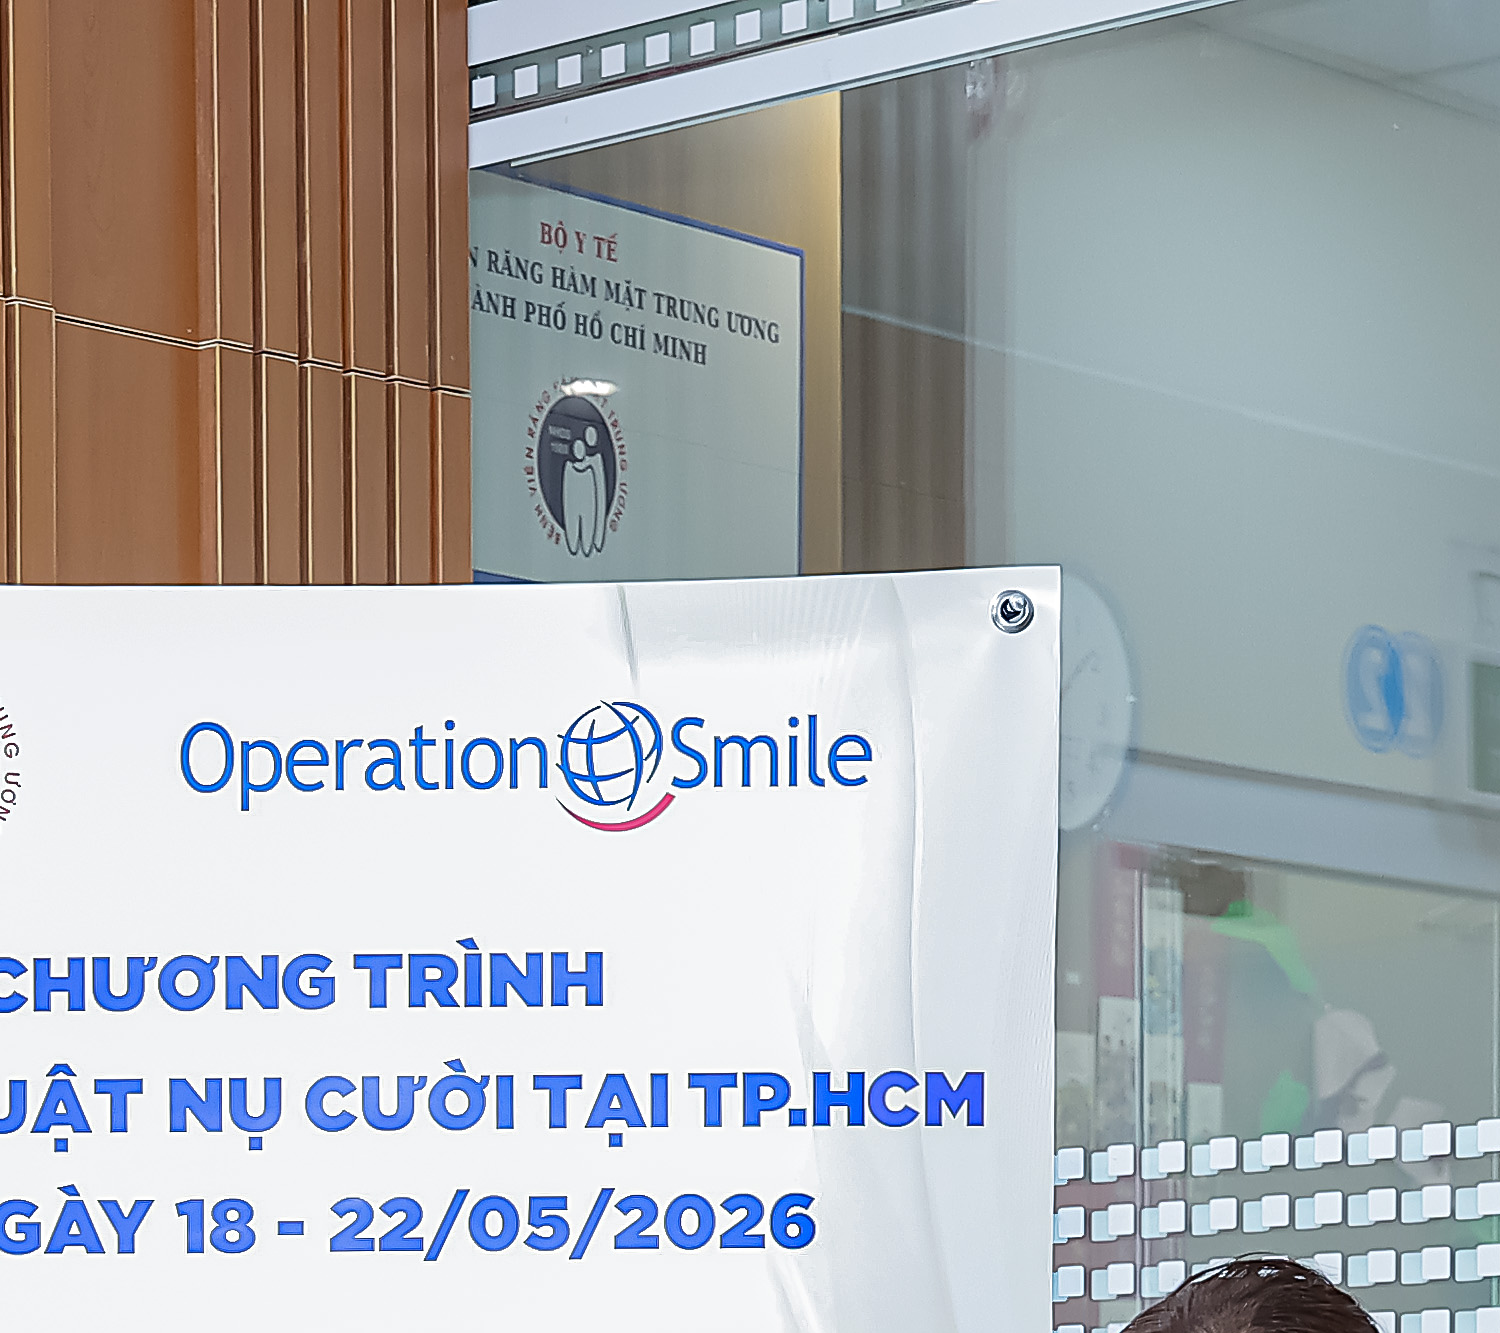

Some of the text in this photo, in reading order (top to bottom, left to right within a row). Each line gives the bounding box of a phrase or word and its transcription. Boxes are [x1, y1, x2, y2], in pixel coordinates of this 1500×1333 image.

[540, 220, 618, 263] BỘ Y TẾ
[471, 284, 516, 320] ÀNH
[524, 301, 566, 331] PHỐ
[610, 322, 645, 350] CHÍ
[653, 333, 707, 365] MINH
[487, 249, 543, 285] RĂNG
[551, 265, 597, 298] HÀM
[604, 280, 646, 312] MẶT
[653, 291, 719, 329] TRUNG
[726, 310, 779, 344] ƯƠNG
[179, 712, 874, 812] Operation Smile
[353, 937, 603, 1008] TRÌNH
[169, 1077, 282, 1151] NỤ
[305, 1058, 514, 1132] CƯỜI
[542, 1073, 669, 1147] TẠI
[688, 1071, 985, 1127] TP.HCM
[175, 1198, 256, 1254] 18
[330, 1188, 816, 1261] 22/05/2026
